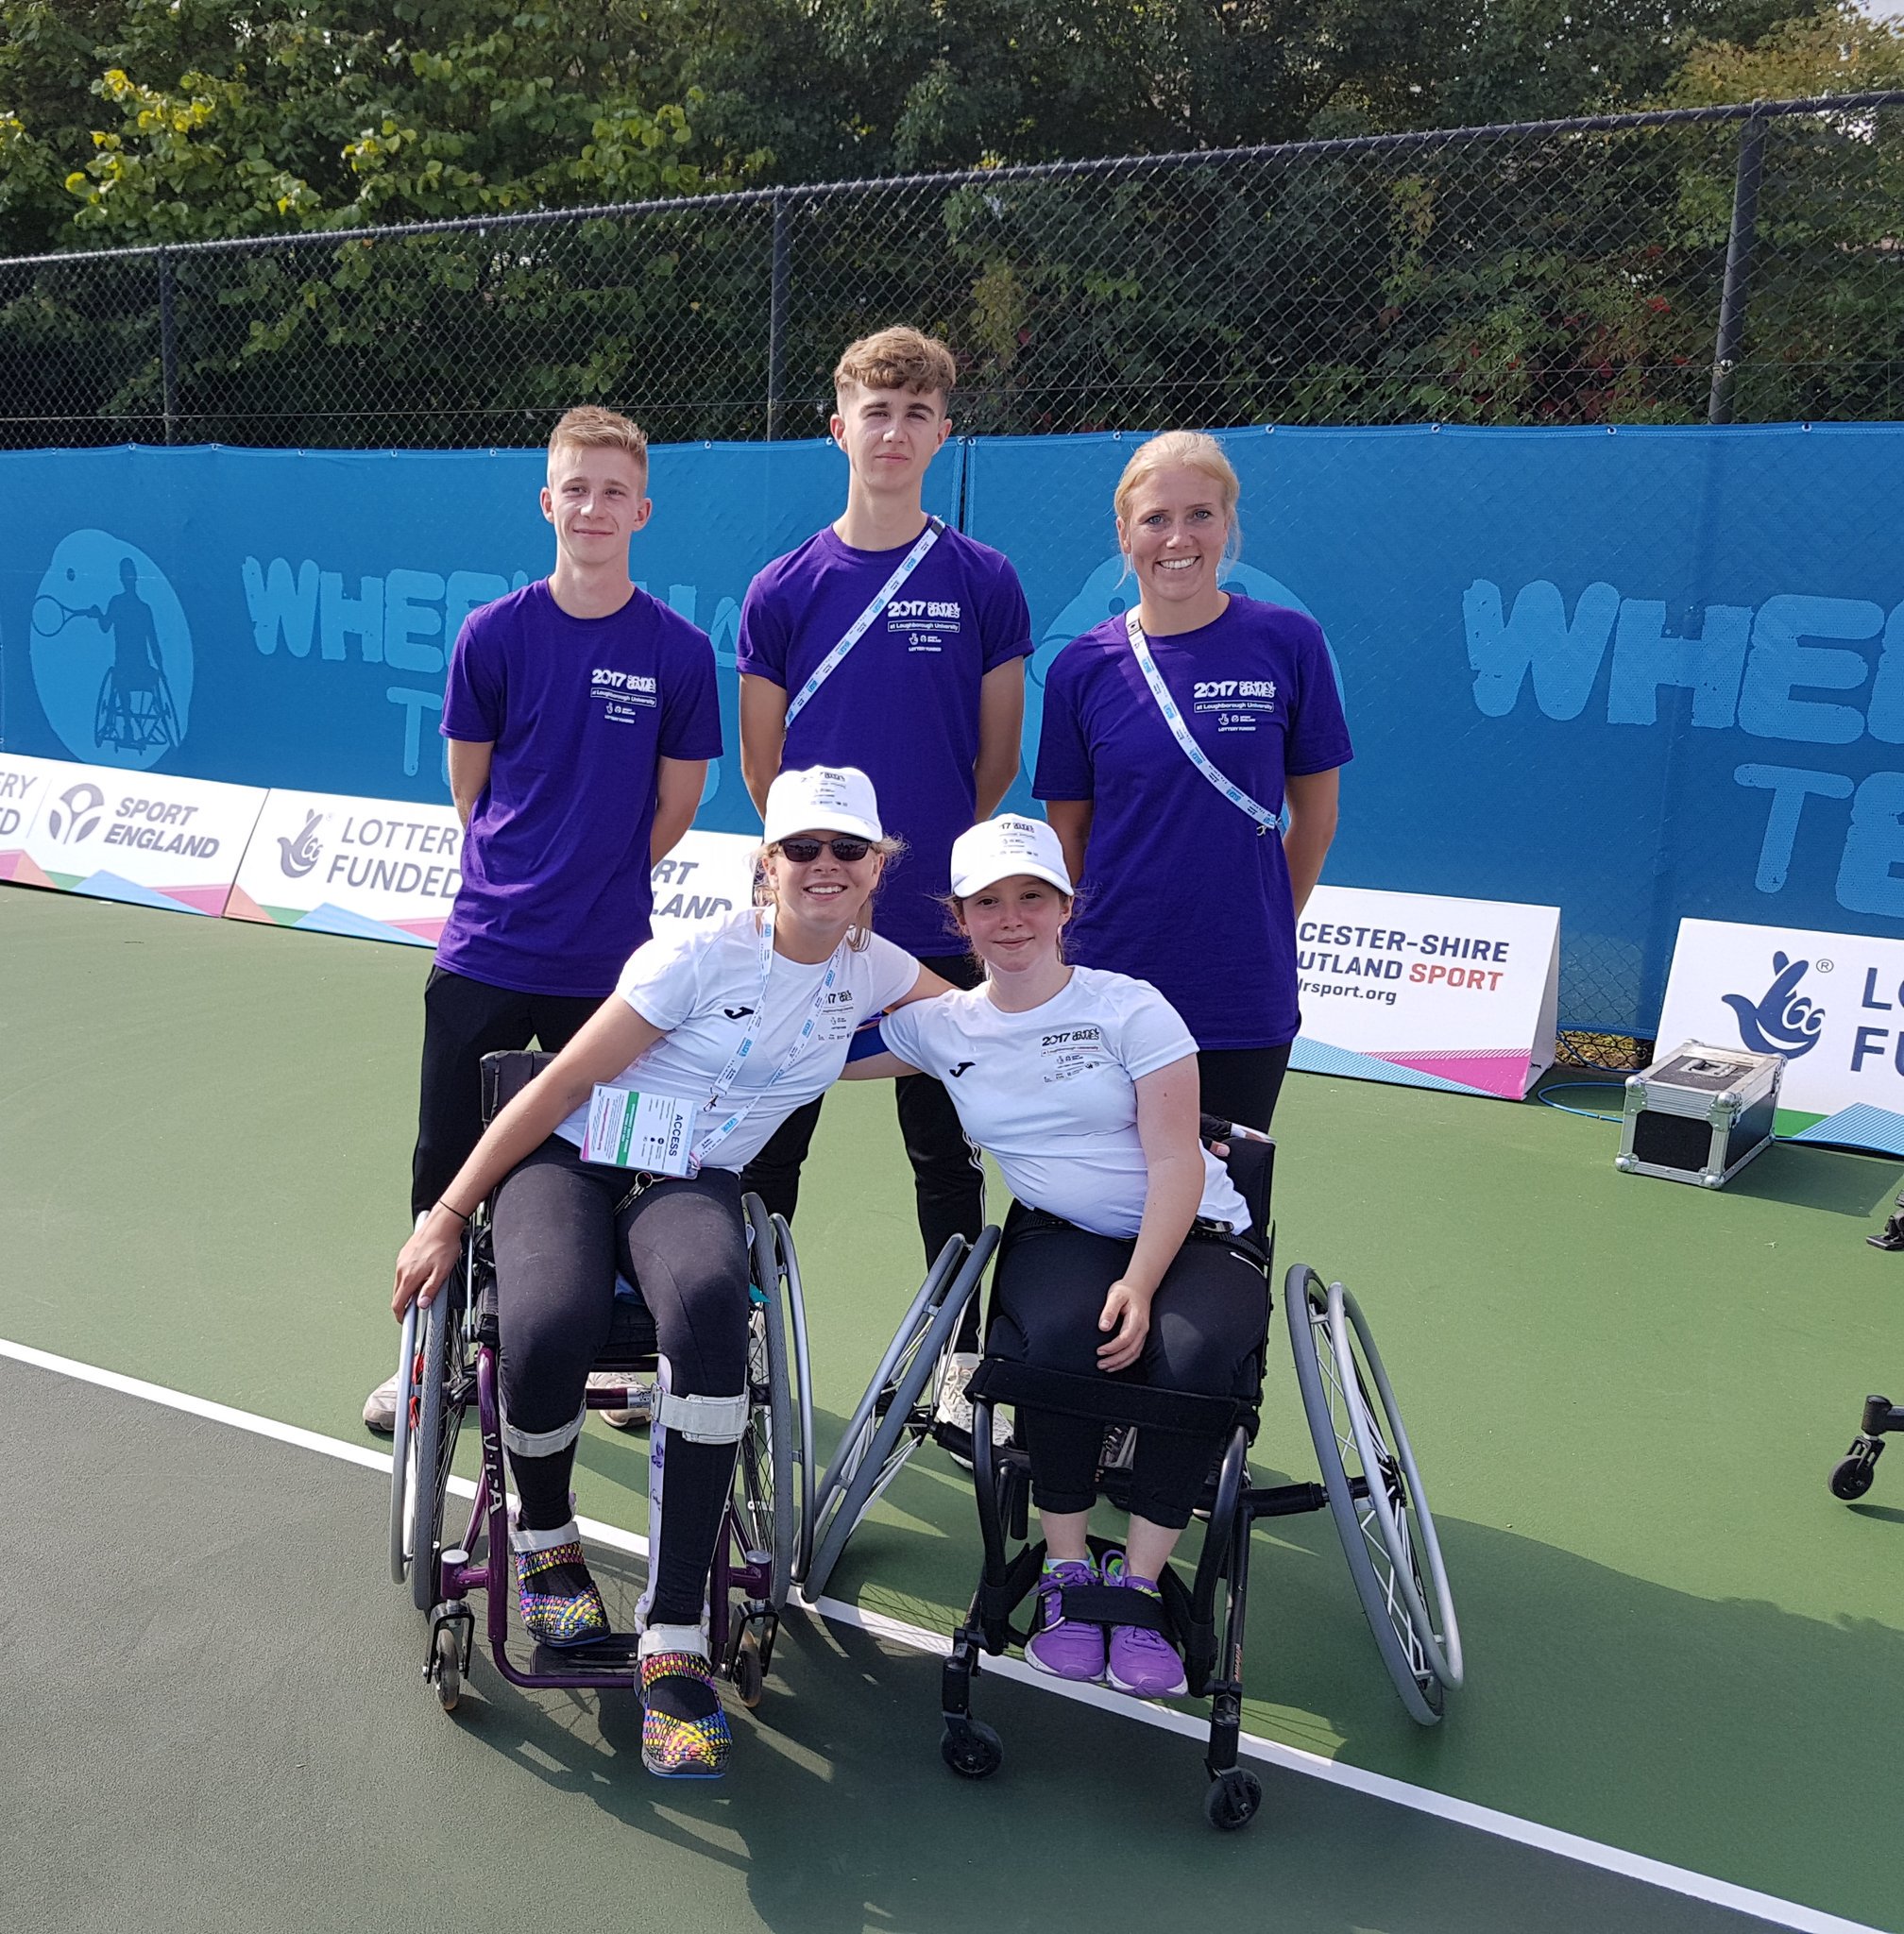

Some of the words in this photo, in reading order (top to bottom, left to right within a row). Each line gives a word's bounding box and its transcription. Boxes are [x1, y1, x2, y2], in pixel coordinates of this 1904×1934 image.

[887, 601, 926, 617] 2017
[1462, 579, 1904, 744] WHE
[591, 669, 627, 687] 2017
[1194, 681, 1238, 698] 2017
[1247, 703, 1273, 711] University
[0, 772, 38, 799] RY
[115, 797, 198, 825] SPORT
[104, 823, 219, 858] ENGLAND
[341, 817, 459, 856] LOTTER
[326, 855, 463, 899] FUNDED
[652, 859, 699, 885] RT
[1299, 922, 1510, 962] CESTER-SHIRE
[1298, 951, 1402, 979] UTLAND
[1409, 963, 1504, 992] SPORT
[1299, 978, 1397, 1006] lrsport.org
[1042, 1032, 1070, 1046] 2017
[669, 1114, 683, 1157] ACCESS
